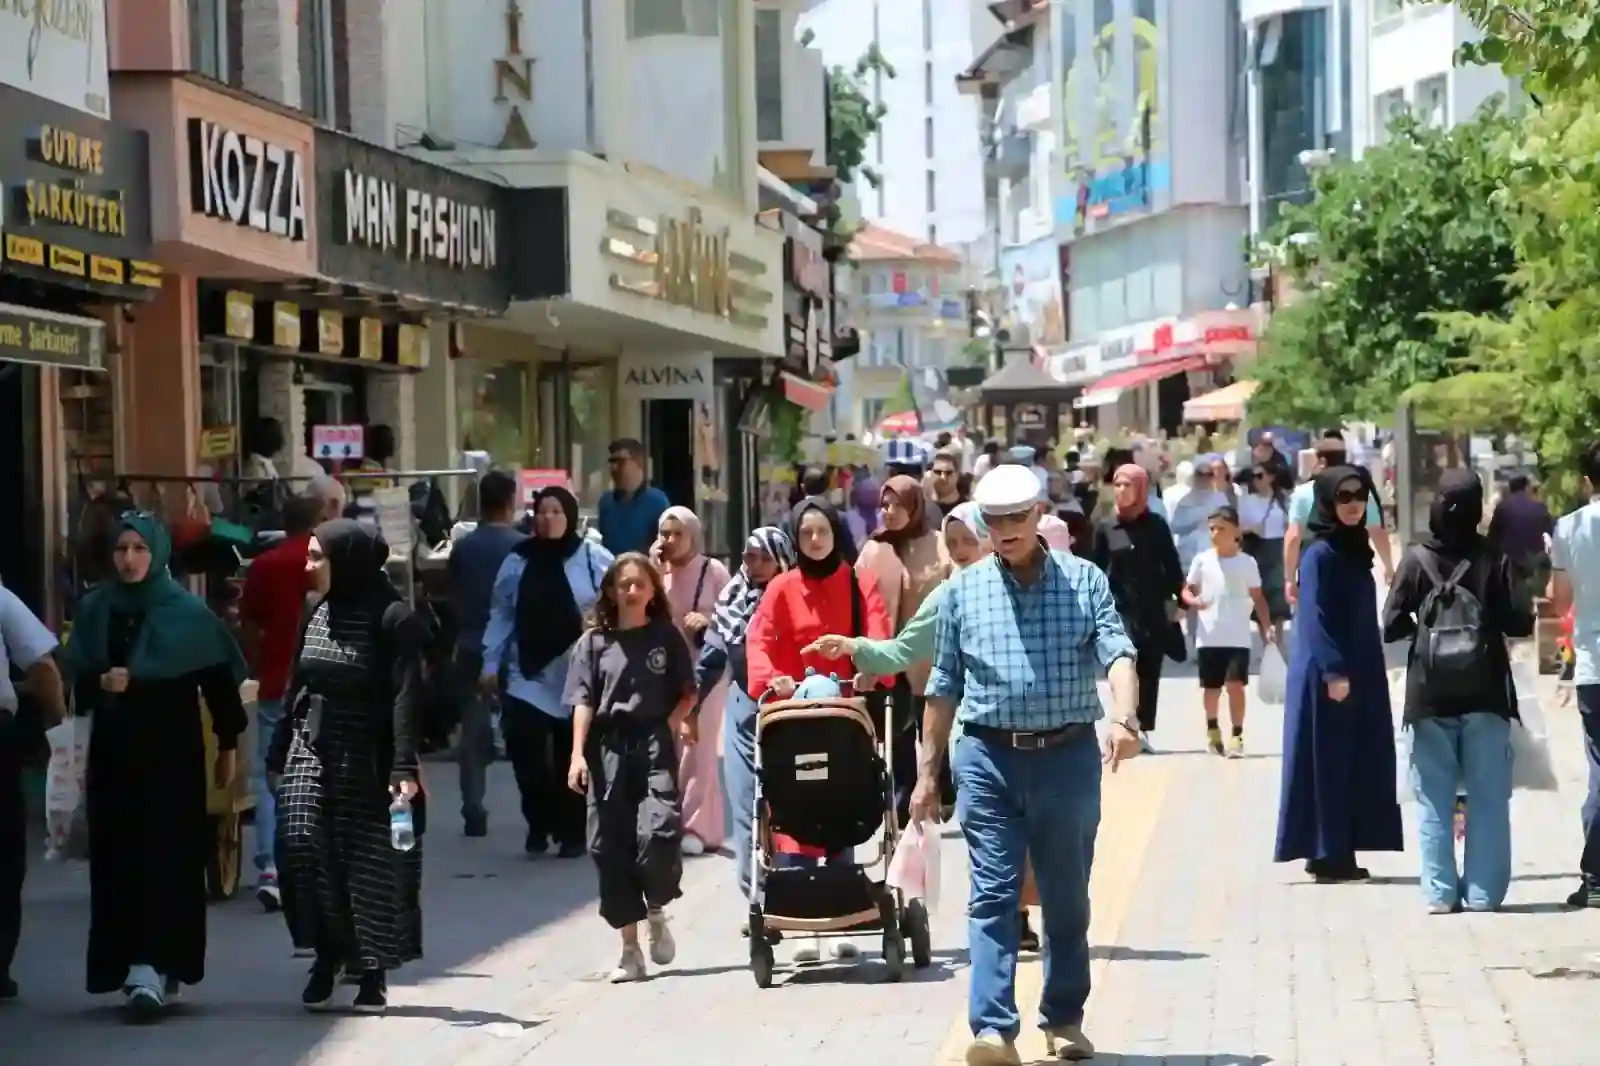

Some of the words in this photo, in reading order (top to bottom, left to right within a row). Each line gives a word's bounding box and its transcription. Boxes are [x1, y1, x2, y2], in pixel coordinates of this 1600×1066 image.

[40, 124, 104, 175] GURME
[201, 120, 308, 241] KOZZA
[26, 178, 127, 237] ŞARKÜTERİ
[345, 168, 397, 253] MAN
[406, 187, 496, 270] FASHION
